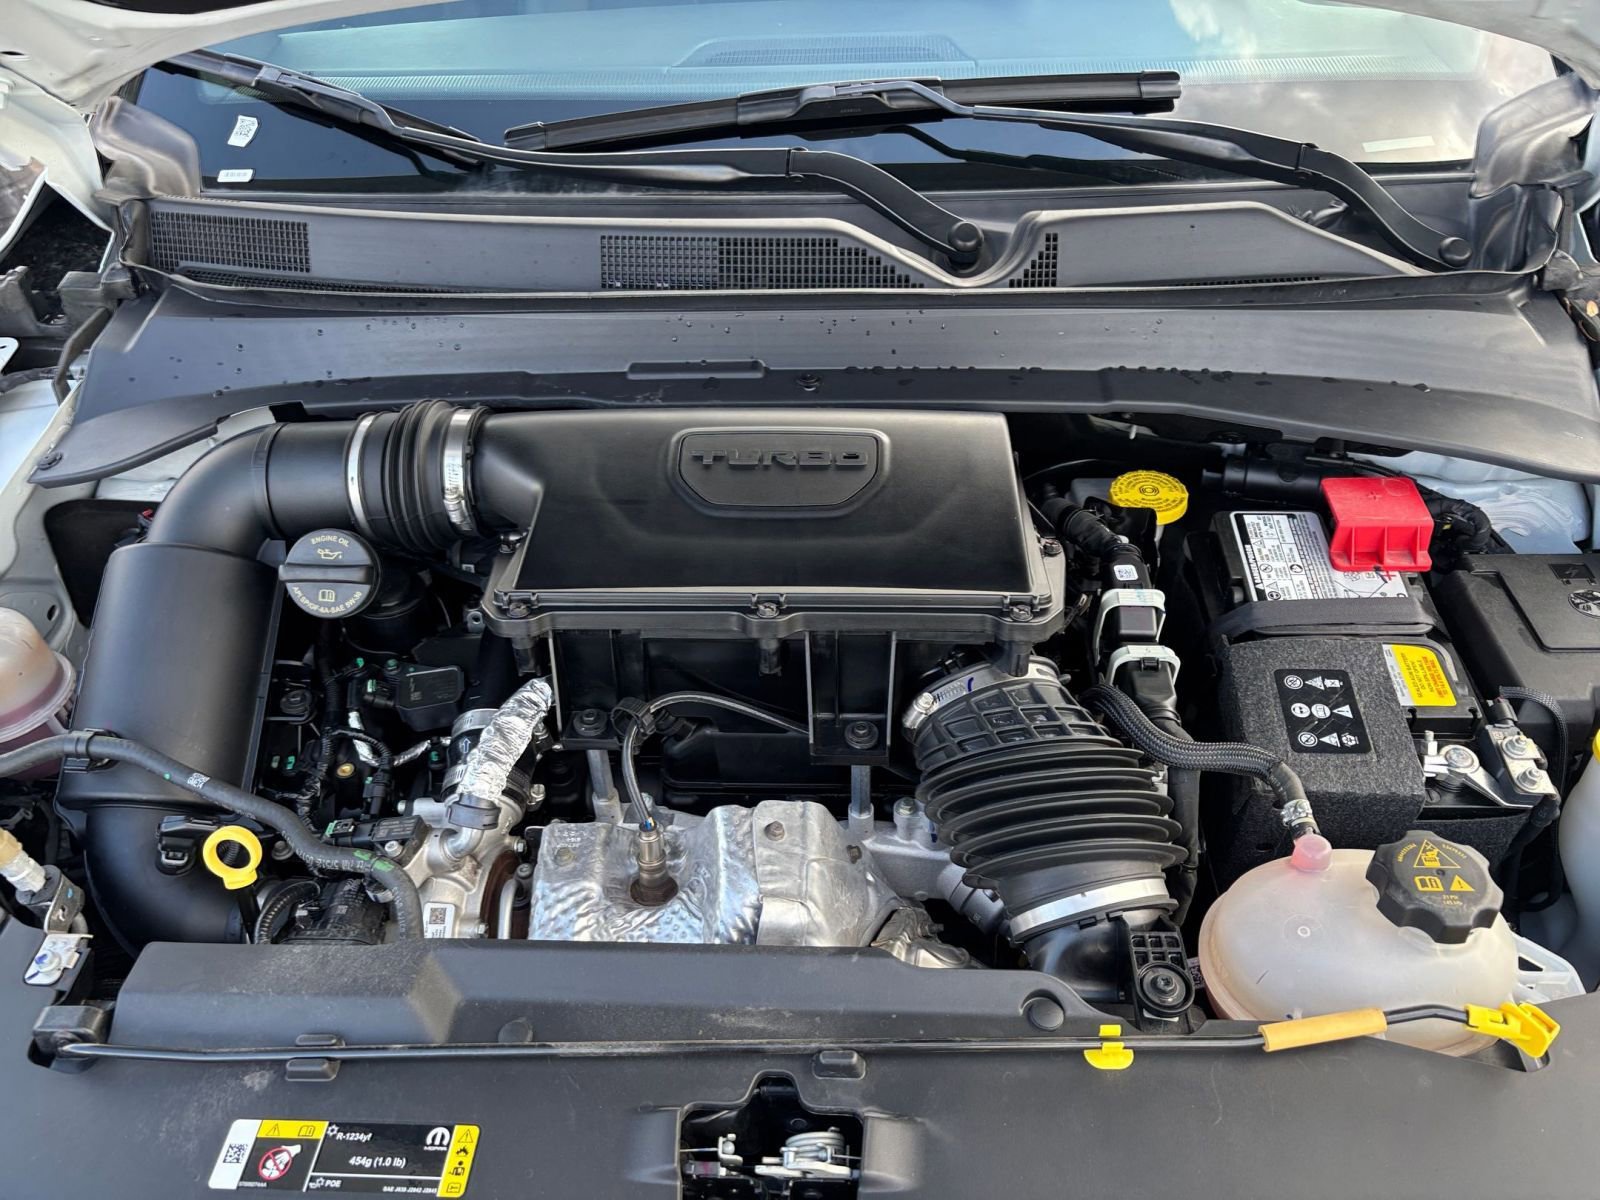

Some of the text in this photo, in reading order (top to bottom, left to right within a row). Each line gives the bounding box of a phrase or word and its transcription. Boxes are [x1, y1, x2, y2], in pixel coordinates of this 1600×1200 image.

[690, 449, 868, 468] TURBO
[311, 535, 351, 547] ENGINE OIL
[336, 1132, 373, 1142] R-1234yf
[348, 1156, 407, 1168] 454g (1.0 lb)
[325, 1179, 342, 1188] POE
